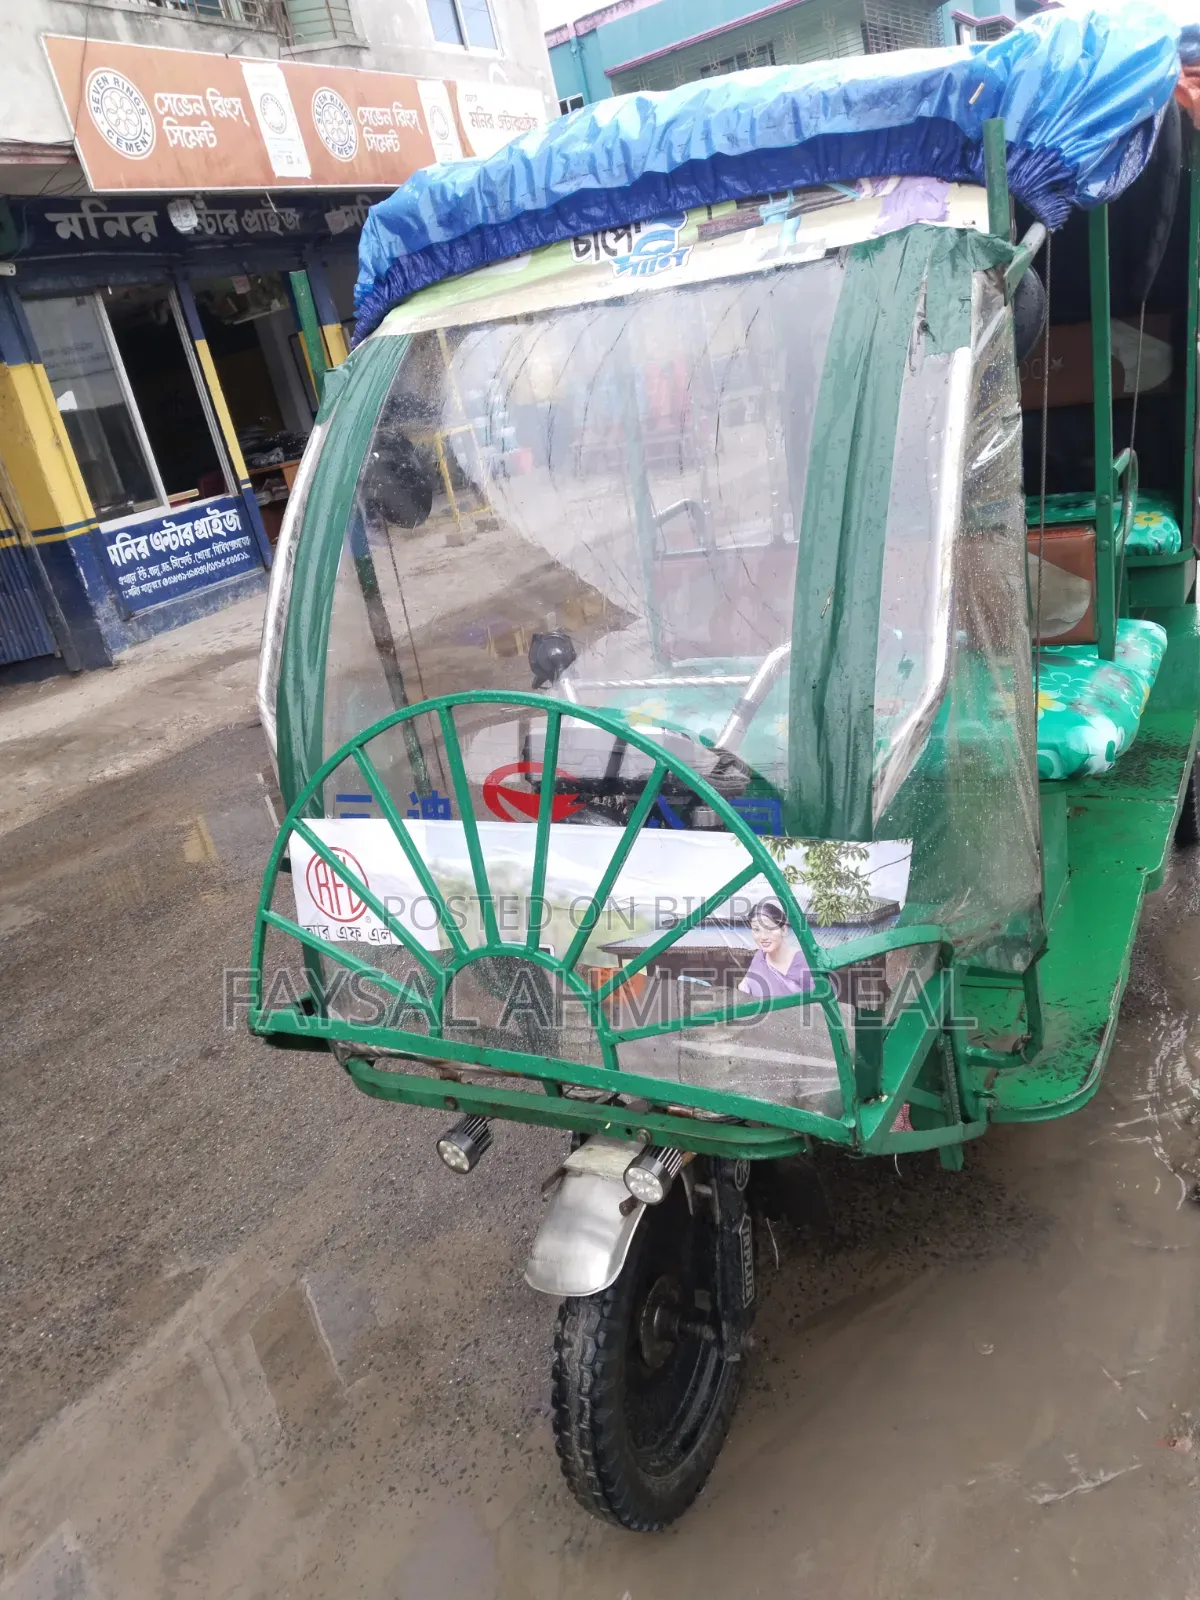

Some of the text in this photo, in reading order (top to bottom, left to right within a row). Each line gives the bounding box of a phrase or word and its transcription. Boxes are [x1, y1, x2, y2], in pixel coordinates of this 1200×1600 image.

[91, 76, 147, 116] SEVEN RINGS
[154, 93, 206, 117] সেভেন
[313, 93, 353, 126] SEVEN RINGS
[357, 107, 391, 127] সেভেন
[106, 129, 151, 152] CEMENT
[162, 117, 217, 149] সিমেন্ট
[325, 136, 355, 156] CEMENT
[363, 127, 400, 153] সিমেন্ট
[44, 199, 158, 243] মনির
[107, 533, 150, 567] মনির
